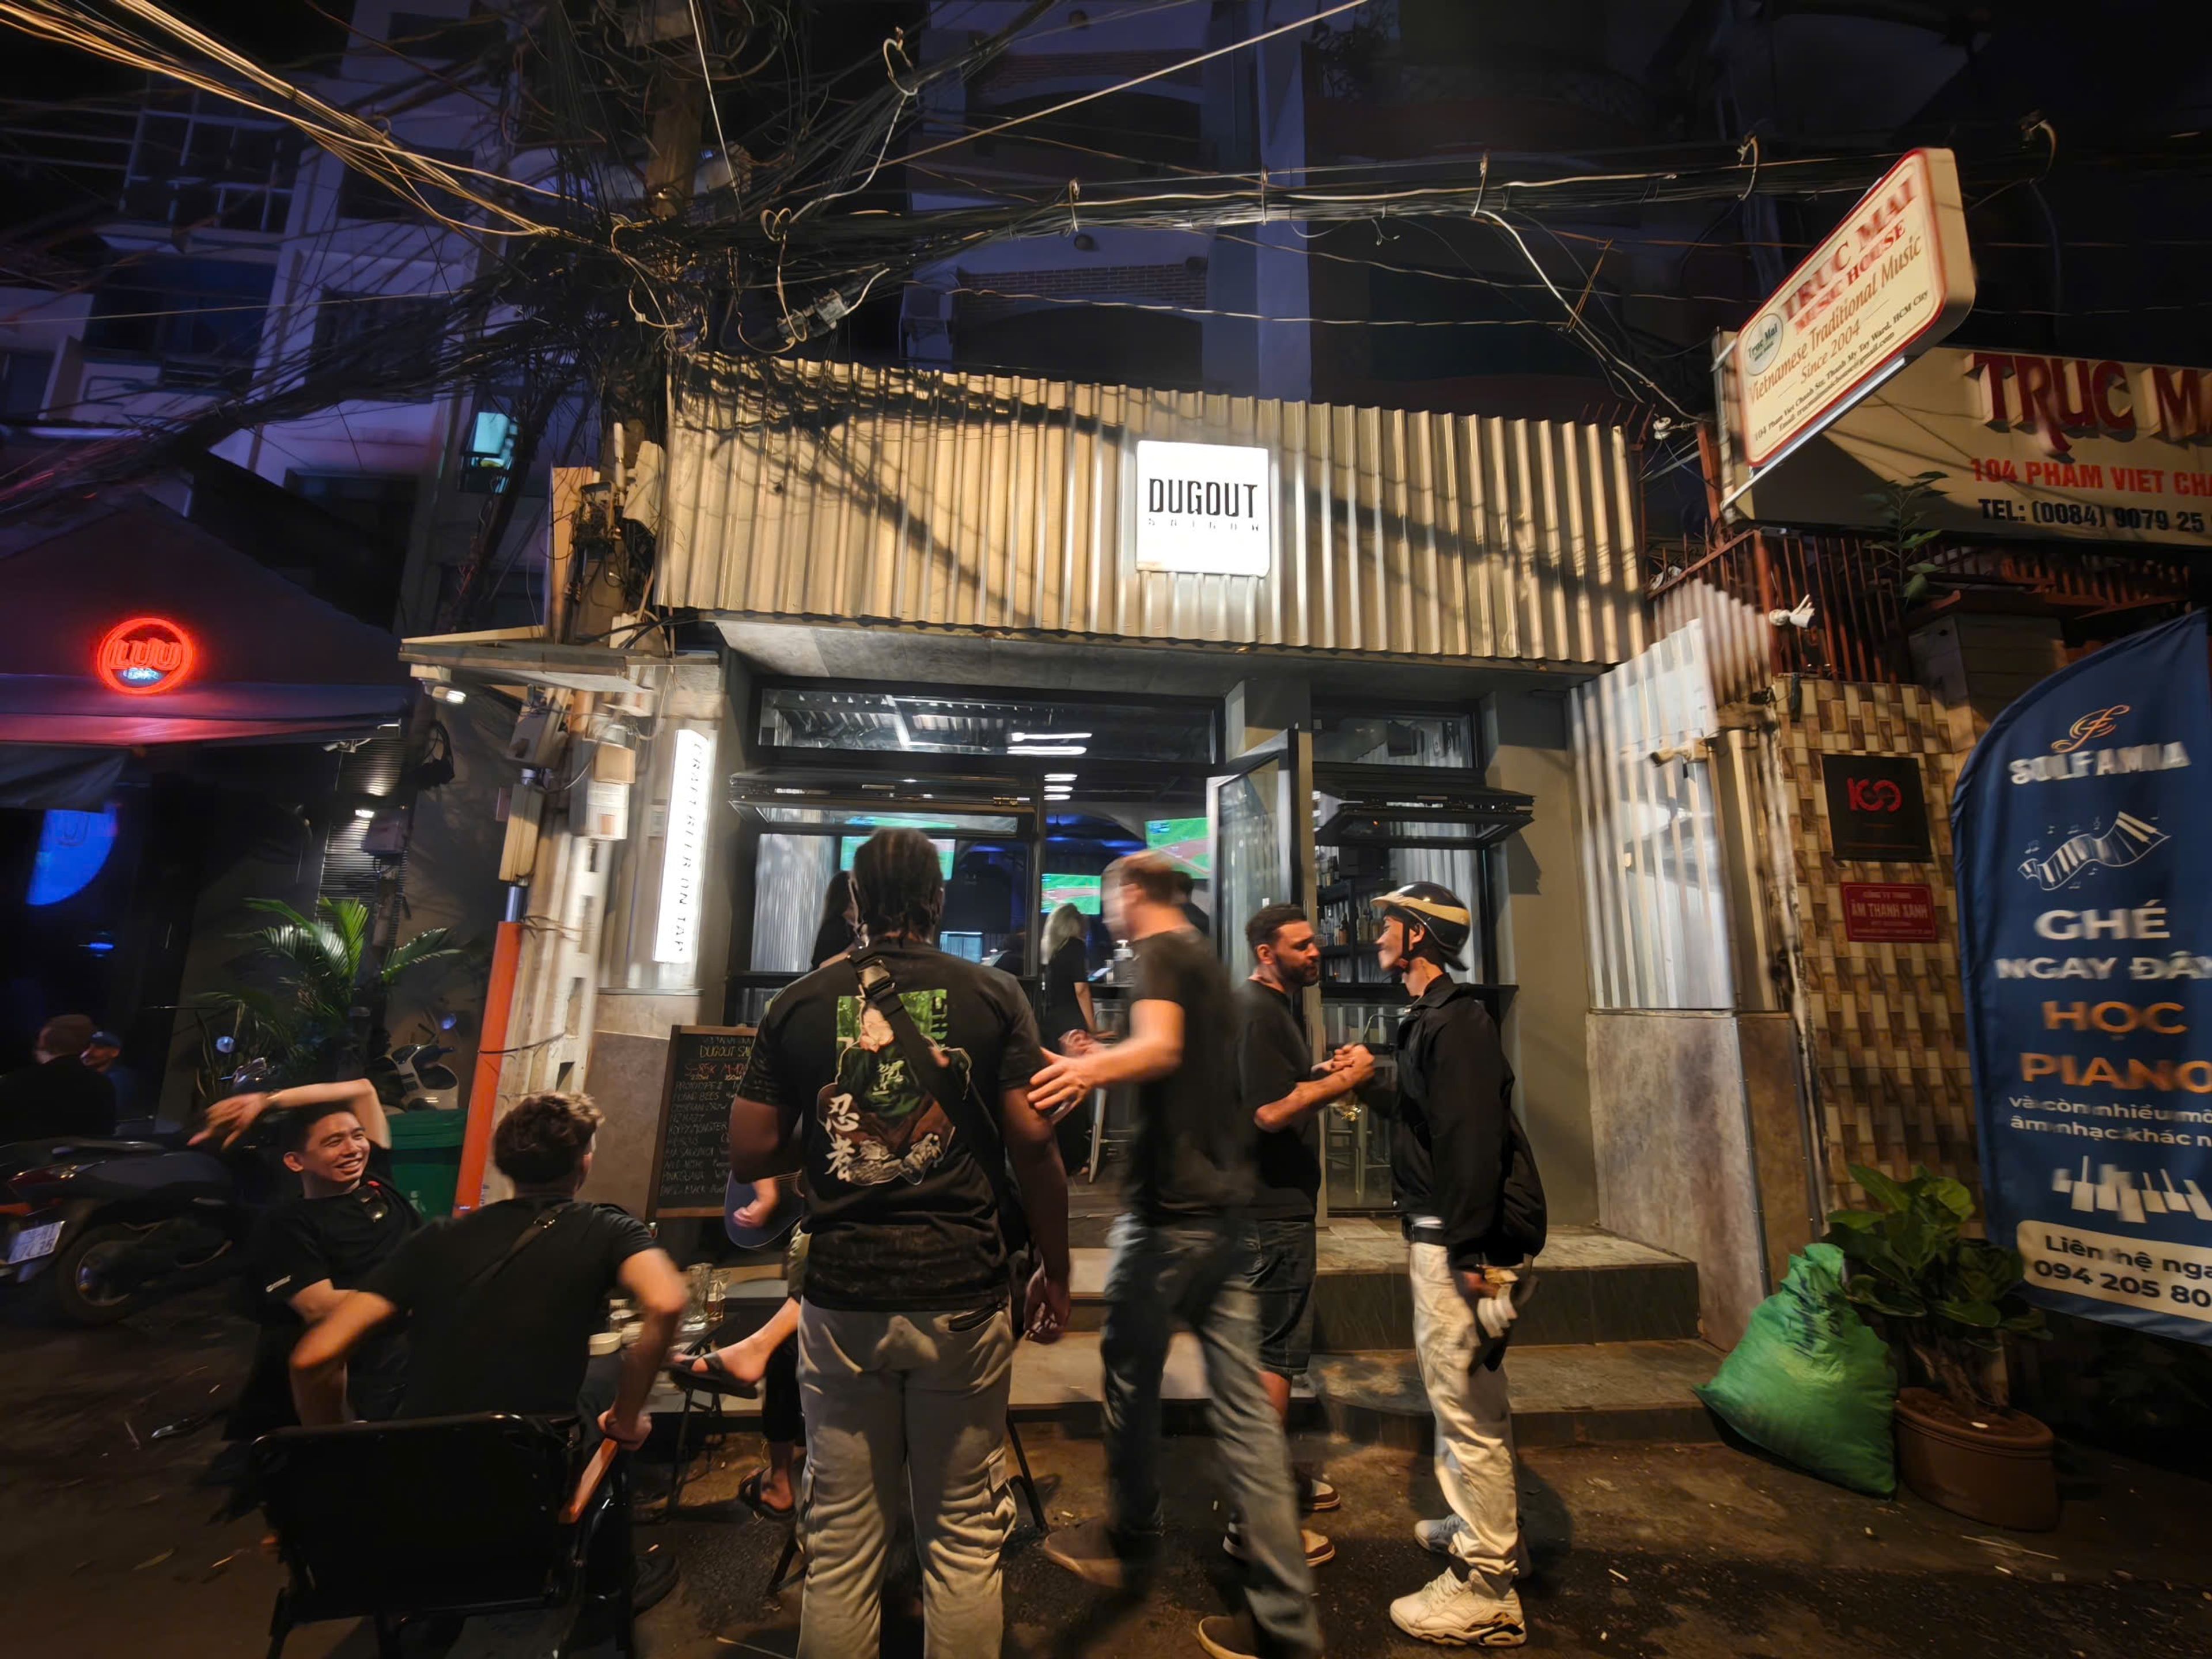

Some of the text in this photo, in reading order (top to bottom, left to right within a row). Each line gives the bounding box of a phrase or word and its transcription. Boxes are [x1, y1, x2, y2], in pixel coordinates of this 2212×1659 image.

[1781, 179, 1916, 322] TRUC MAI
[1847, 219, 1906, 286] HOUSE
[1749, 235, 1922, 404] Vietnamese Traditional Music
[1893, 303, 1912, 324] HCM
[1801, 352, 1828, 385] Since
[1831, 318, 1861, 359] 2004
[1964, 353, 2135, 453] TRUC
[1971, 458, 2019, 483] 104
[2025, 461, 2103, 490] PHAM
[2110, 467, 2165, 494] VIET
[1149, 478, 1258, 518] DUGOUT
[1979, 498, 2205, 533] TEL: (0084) 9079 25
[2034, 899, 2171, 941] GHÉ
[1994, 957, 2118, 979] NGAY
[2041, 1001, 2190, 1041] HỌC
[2019, 1052, 2212, 1094] PIANO
[2009, 1096, 2037, 1109] và
[2043, 1098, 2090, 1115] còn
[2010, 1115, 2048, 1131] âm
[2054, 1122, 2118, 1141] nhạc
[2122, 1127, 2192, 1146] khác
[2045, 1235, 2104, 1260] Liên
[2109, 1247, 2153, 1272] hệ
[2033, 1259, 2211, 1308] 094 205 80
